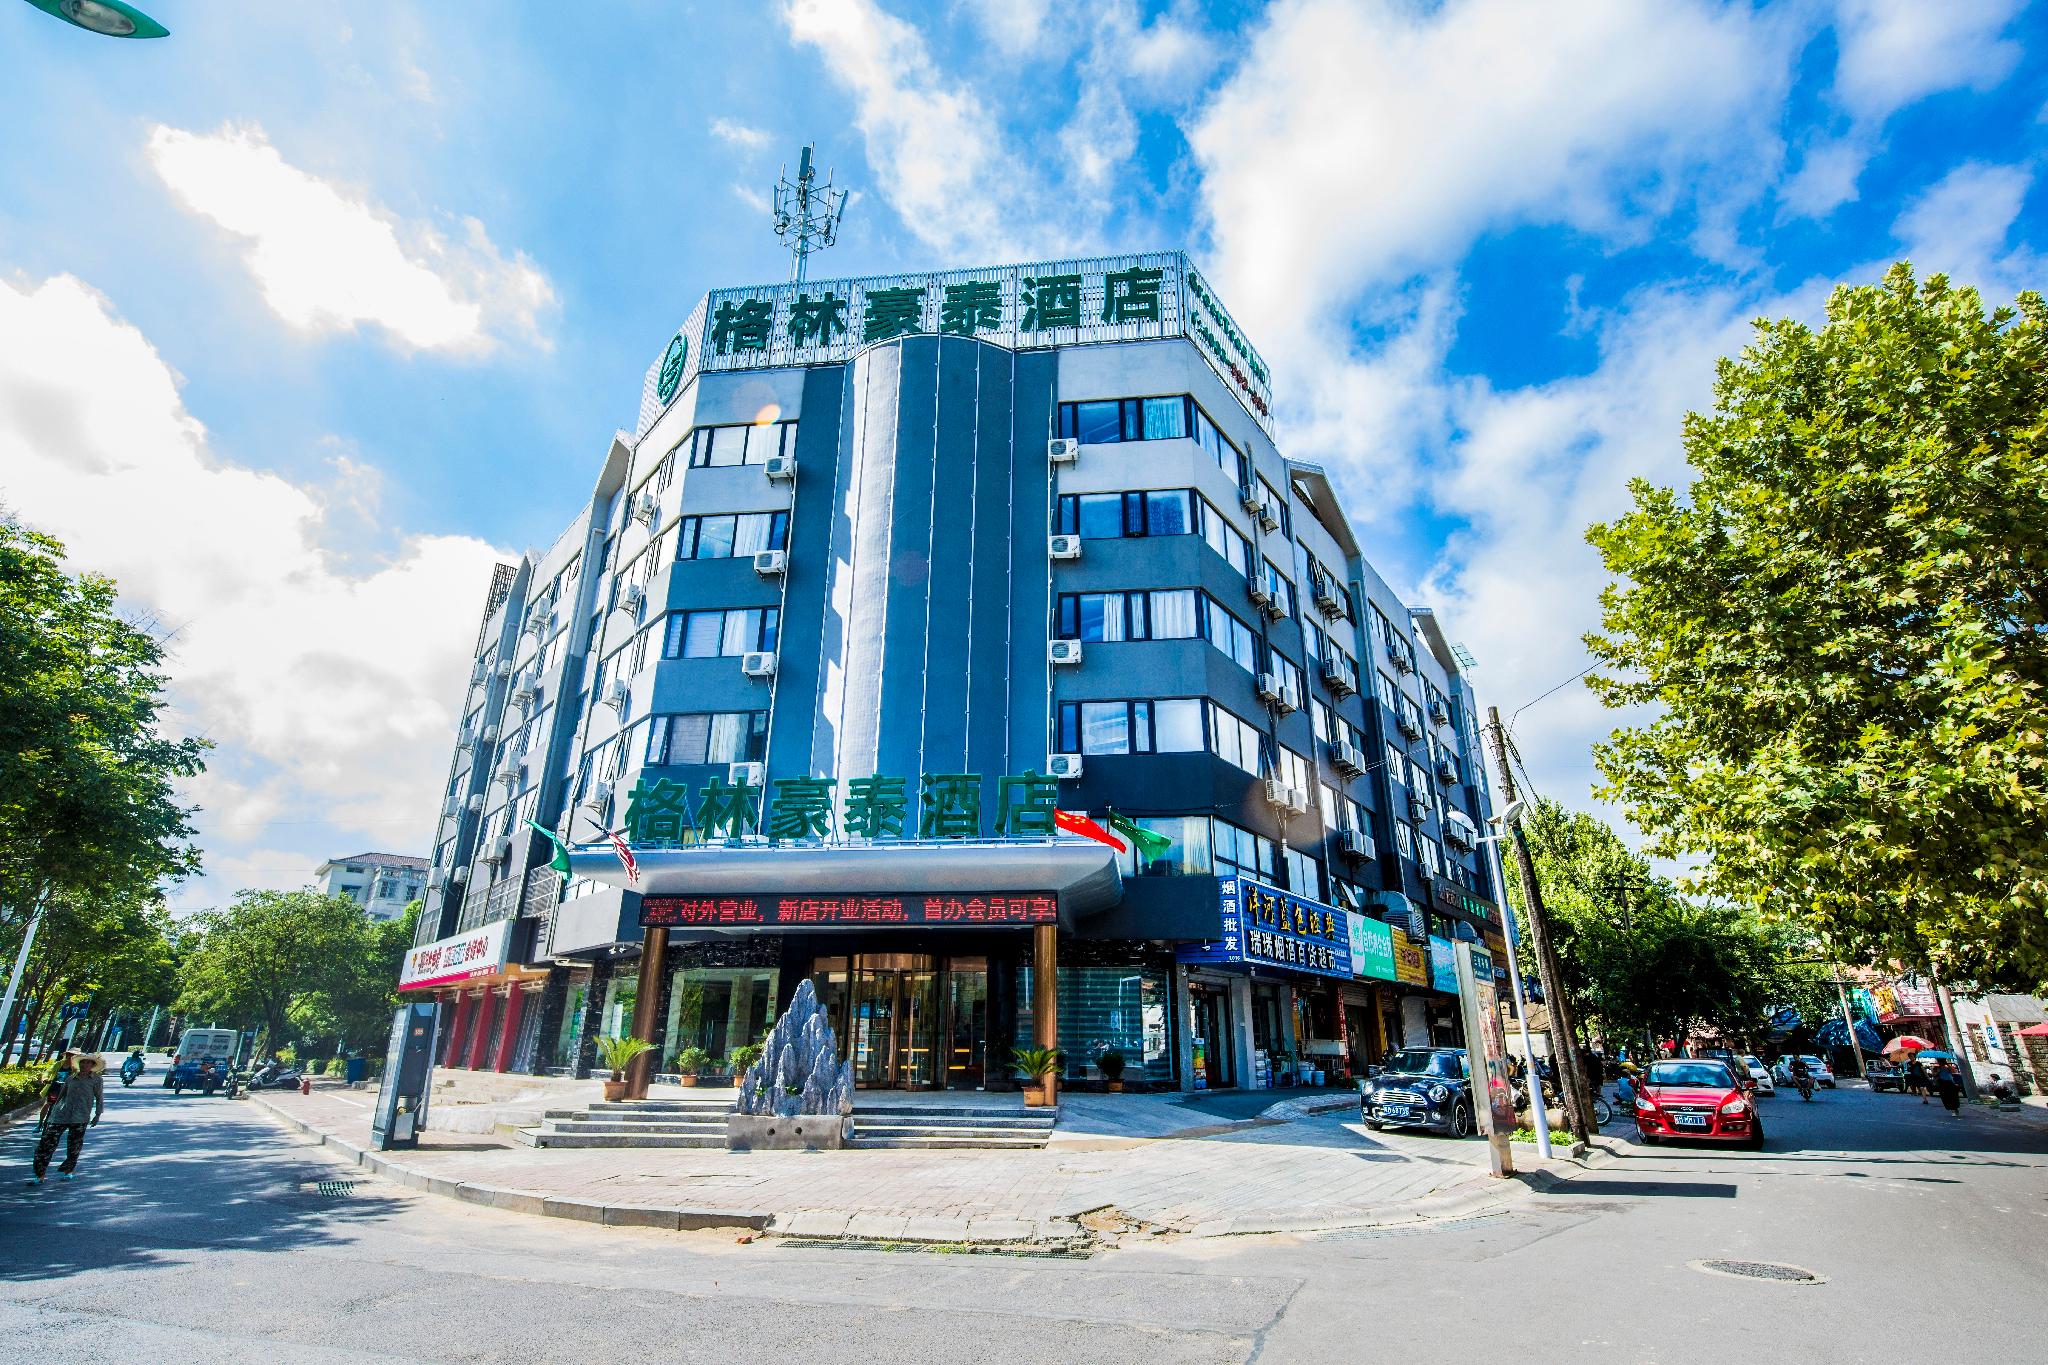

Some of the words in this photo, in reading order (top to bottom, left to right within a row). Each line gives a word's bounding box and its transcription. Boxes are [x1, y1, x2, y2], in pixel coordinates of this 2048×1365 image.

[711, 266, 1165, 354] 格林豪泰酒店
[624, 769, 1059, 842] 格林豪泰酒店
[923, 896, 1057, 921] 首办会员可享
[1221, 880, 1239, 952] 烟酒批发
